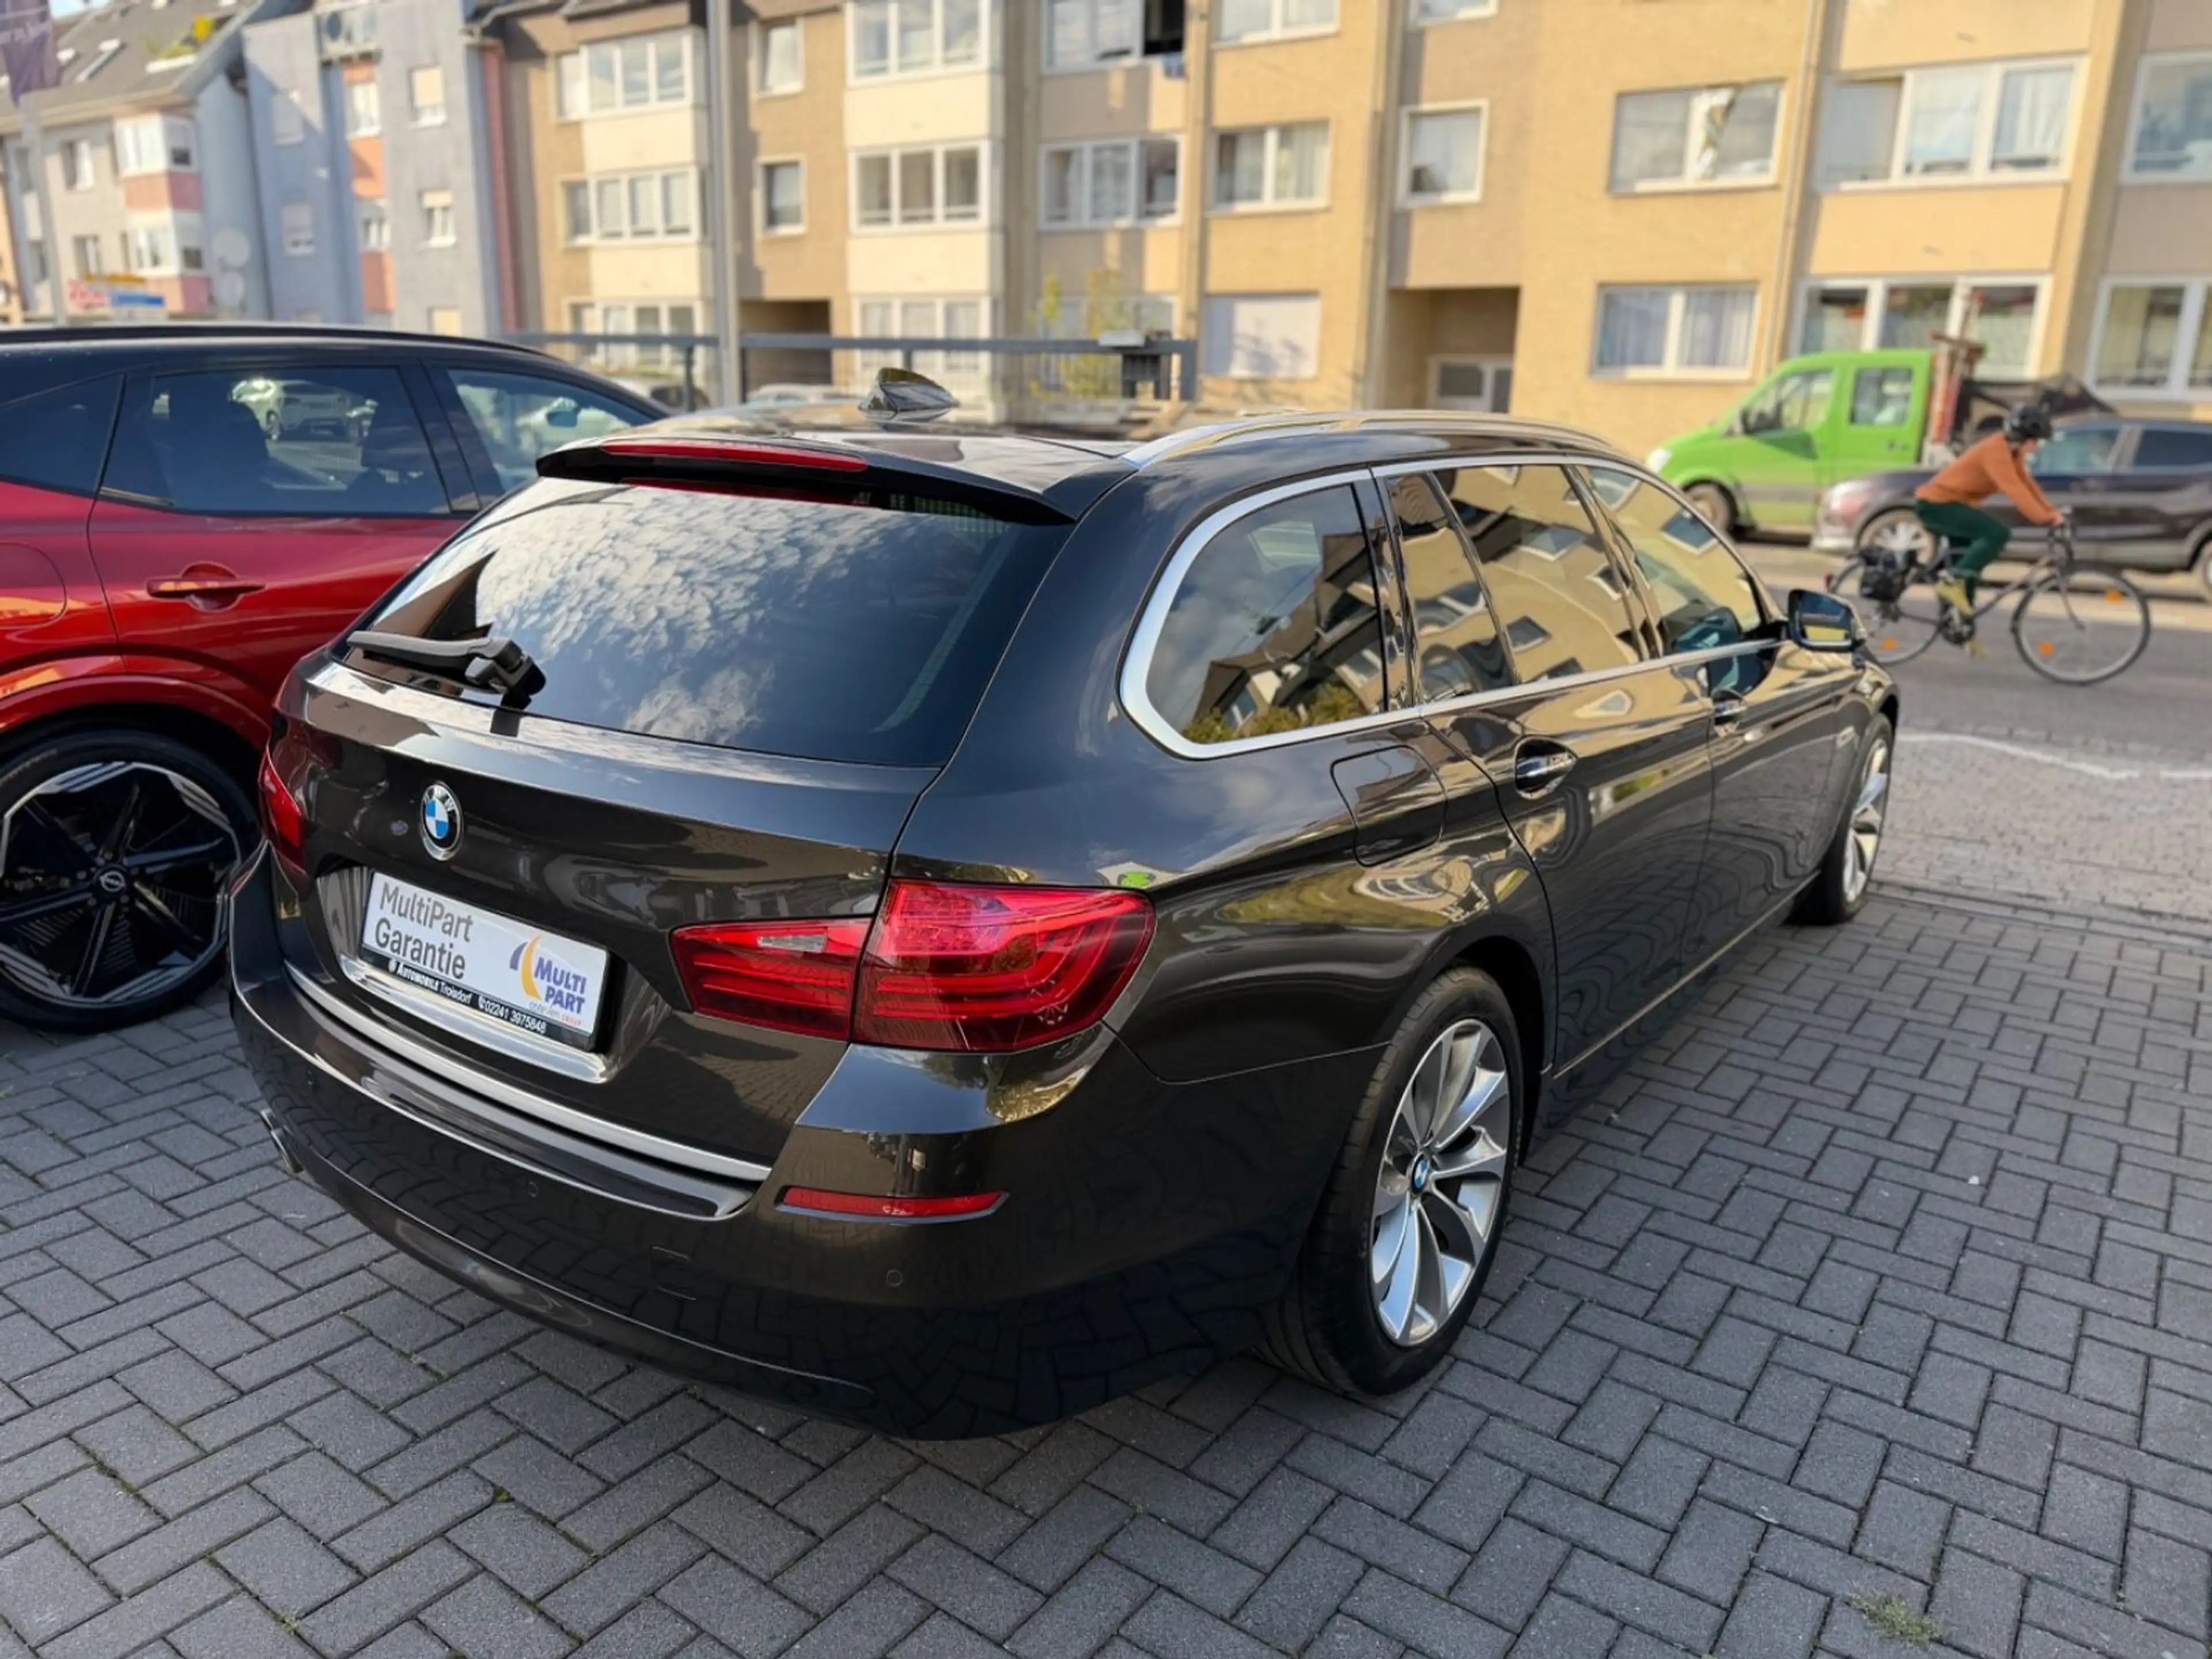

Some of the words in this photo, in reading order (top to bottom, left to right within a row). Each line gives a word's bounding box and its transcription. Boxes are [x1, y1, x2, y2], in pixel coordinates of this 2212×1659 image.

[380, 881, 474, 943] MultiPart
[375, 917, 466, 980] Garantie
[534, 956, 588, 994] MULTI
[544, 985, 586, 1014] PART
